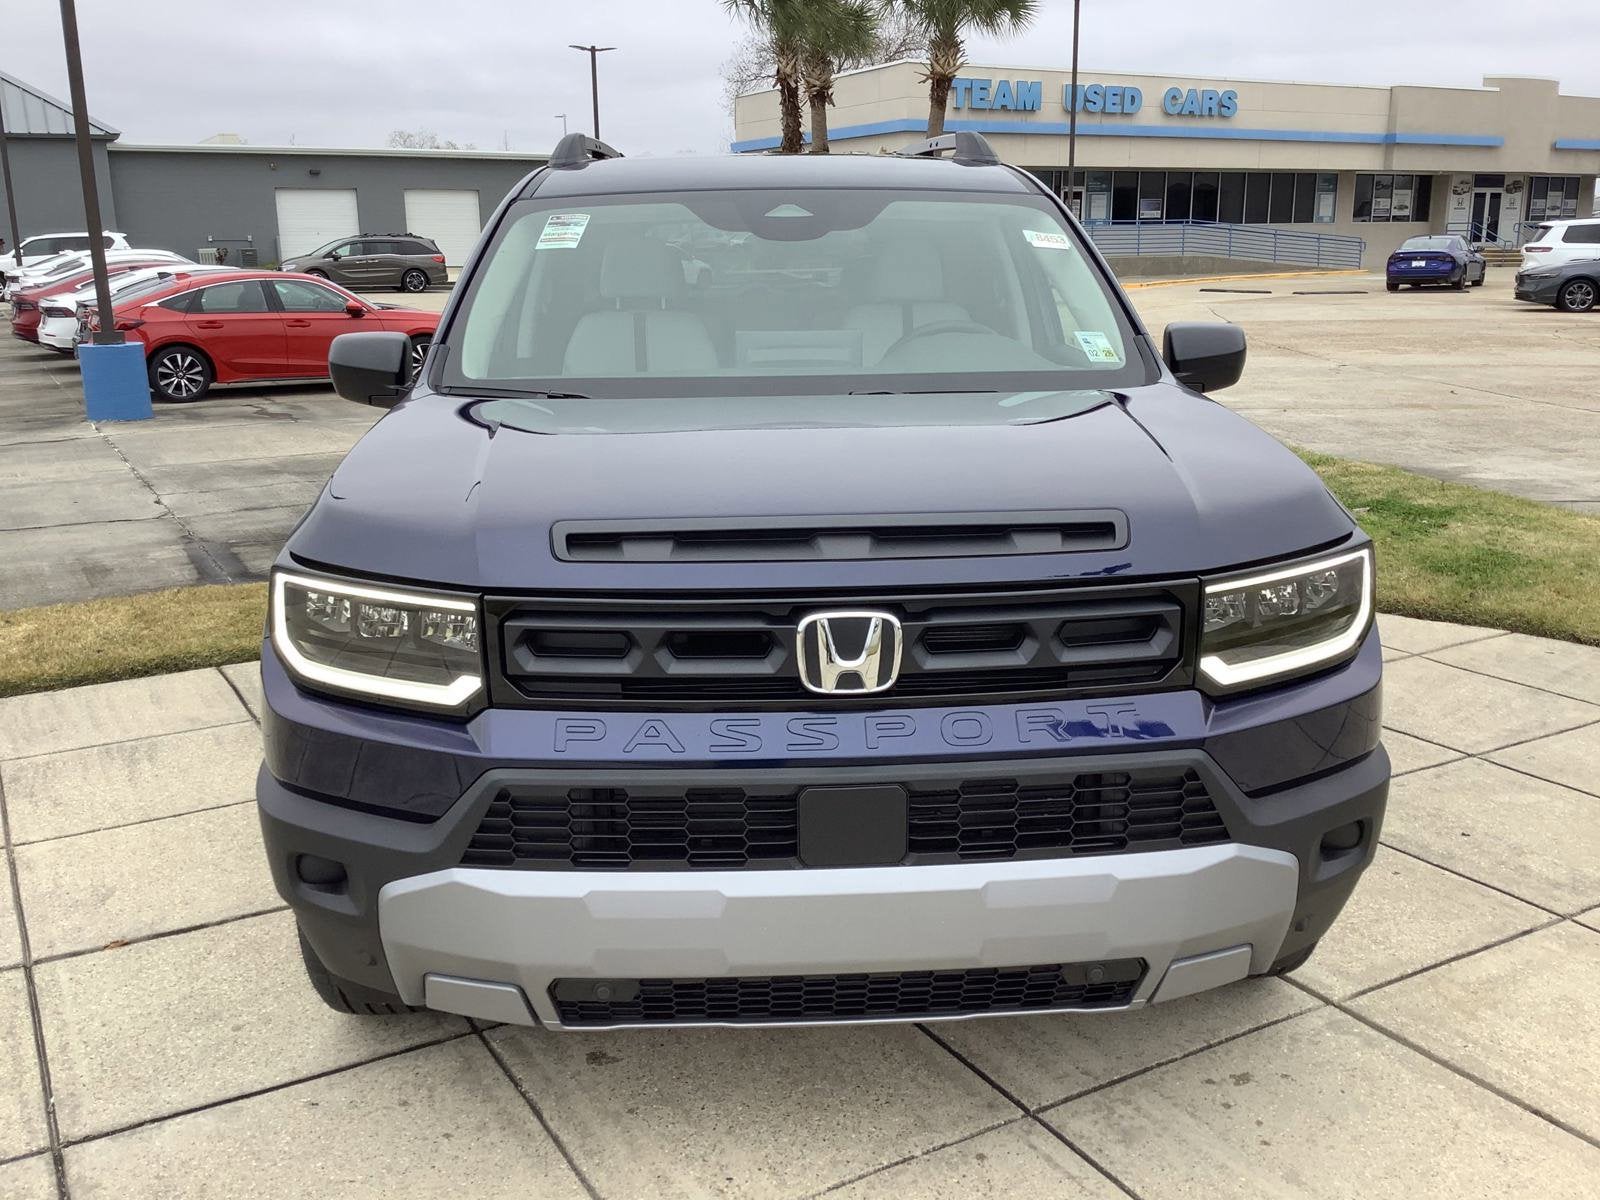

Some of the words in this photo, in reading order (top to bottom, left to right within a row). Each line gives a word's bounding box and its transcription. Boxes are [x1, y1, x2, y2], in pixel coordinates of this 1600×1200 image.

[951, 78, 1042, 111] TEAM
[1063, 84, 1143, 114] USED
[1163, 87, 1238, 117] CARS
[553, 702, 1138, 753] PASSPORT
